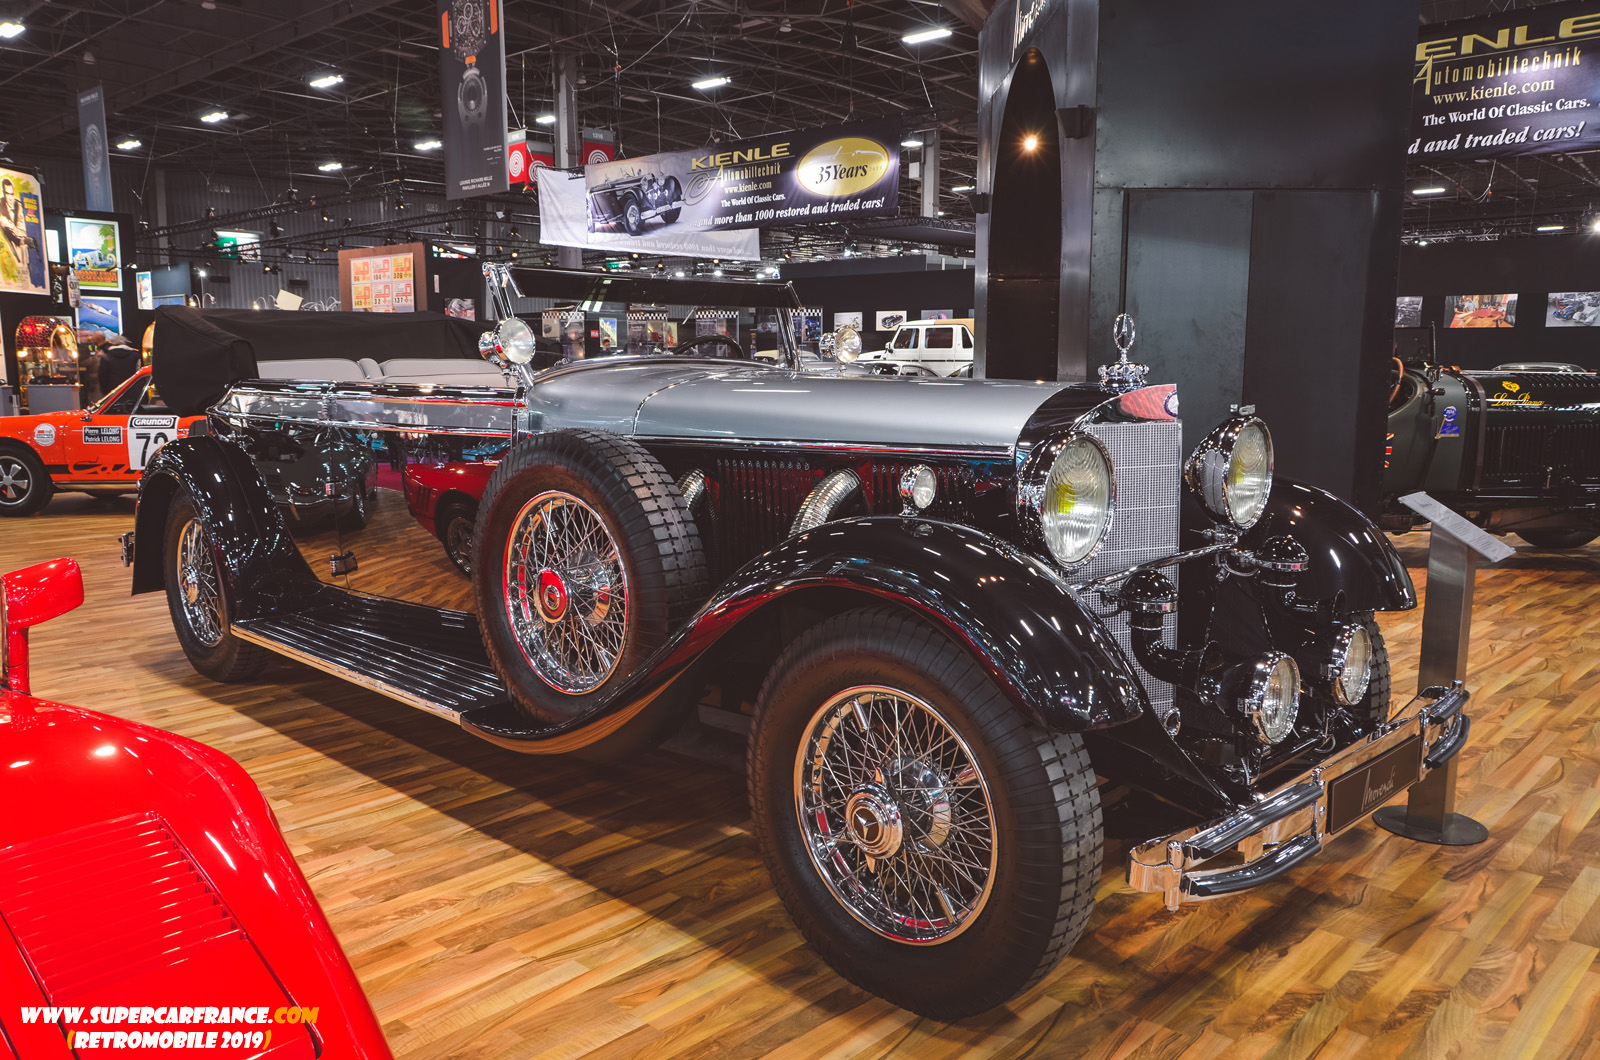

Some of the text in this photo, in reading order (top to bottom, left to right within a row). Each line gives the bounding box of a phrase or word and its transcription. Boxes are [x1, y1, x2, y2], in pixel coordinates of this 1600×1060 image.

[1413, 46, 1582, 95] Automobiltechnik
[1433, 79, 1555, 105] www.kienle.com
[1422, 98, 1591, 126] The World Of Classic Cars.
[1424, 133, 1462, 153] and
[1464, 125, 1531, 149] traded
[1533, 120, 1587, 142] cars!
[691, 142, 790, 170] KIENLE
[700, 162, 781, 190] Automobiltechnik
[724, 180, 772, 195] www.kienle.com
[714, 213, 734, 225] more
[735, 211, 753, 223] than
[754, 209, 774, 221] 1000
[775, 204, 810, 219] restored
[812, 202, 829, 215] and
[830, 199, 860, 213] traded
[862, 197, 885, 209] cars!
[721, 192, 786, 208] The World Of Classic Cars.
[135, 418, 172, 426] GRUNDIG
[101, 435, 120, 443] LELONG
